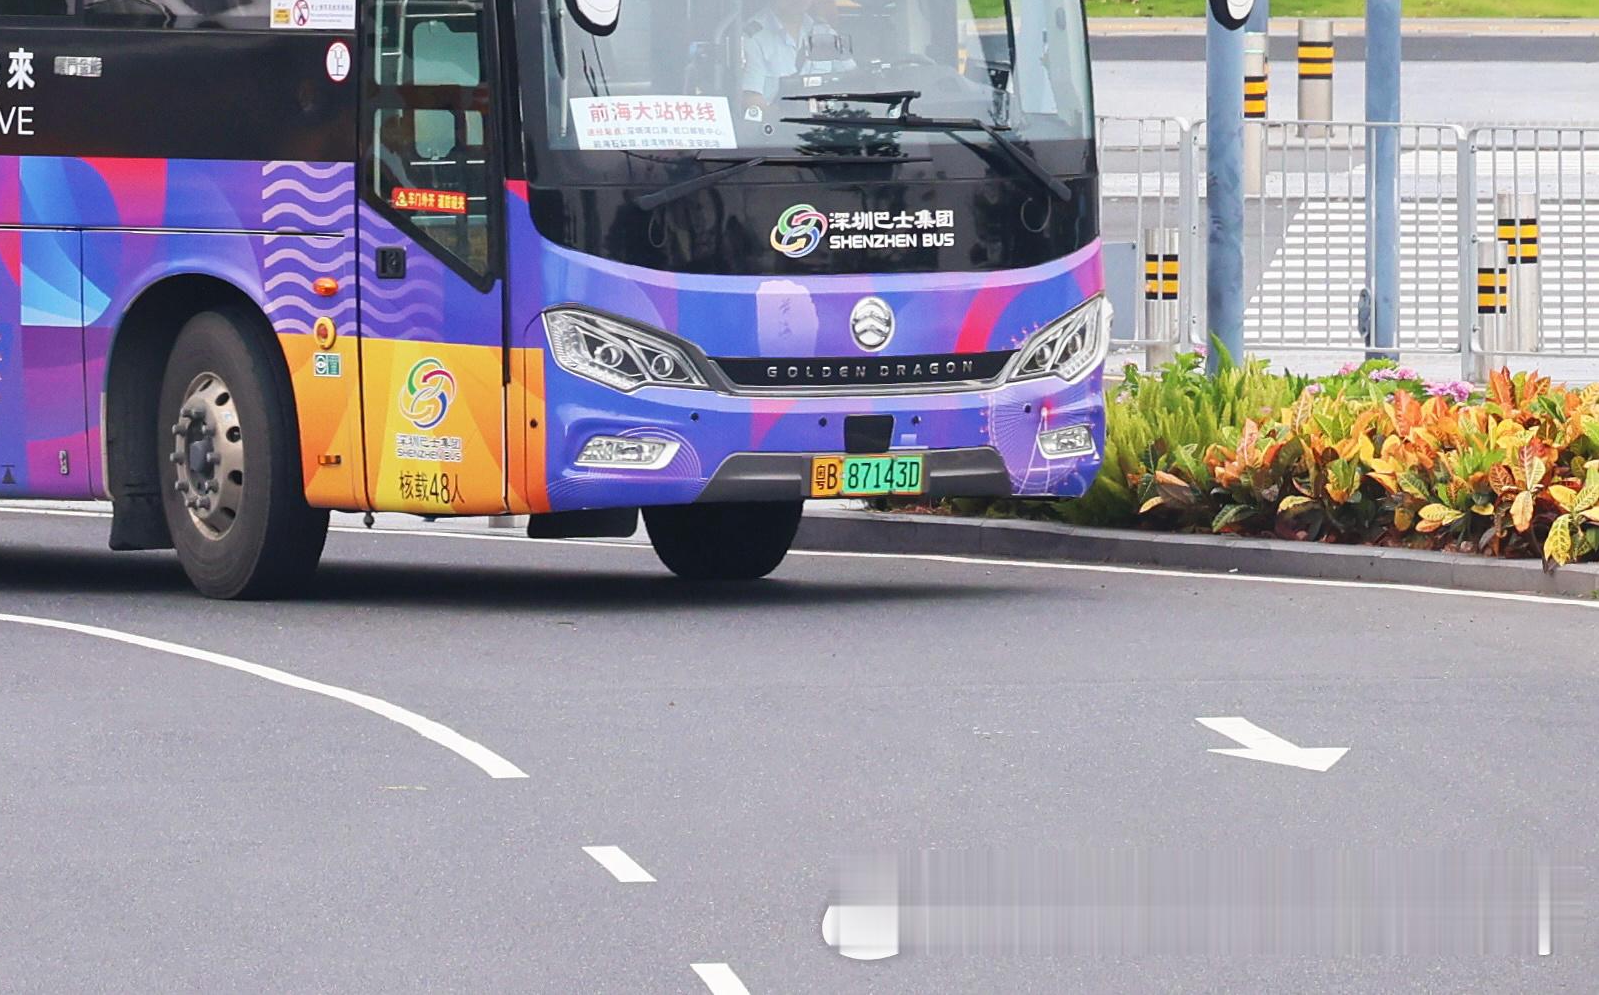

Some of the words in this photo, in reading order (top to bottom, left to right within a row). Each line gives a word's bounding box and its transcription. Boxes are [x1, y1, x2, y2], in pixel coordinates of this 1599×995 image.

[587, 101, 717, 123] 前海大站快线
[828, 209, 955, 232] 深圳巴士集团
[829, 234, 917, 250] SHENZHEN
[922, 233, 955, 249] BUS
[766, 365, 867, 379] GOLDEN
[879, 360, 975, 377] DRAGON
[397, 435, 462, 450] 深圳巴士集团
[397, 448, 443, 460] SHENZHEN
[444, 451, 462, 461] BUS
[847, 461, 921, 490] 87143D
[399, 470, 465, 504] 核载48人
